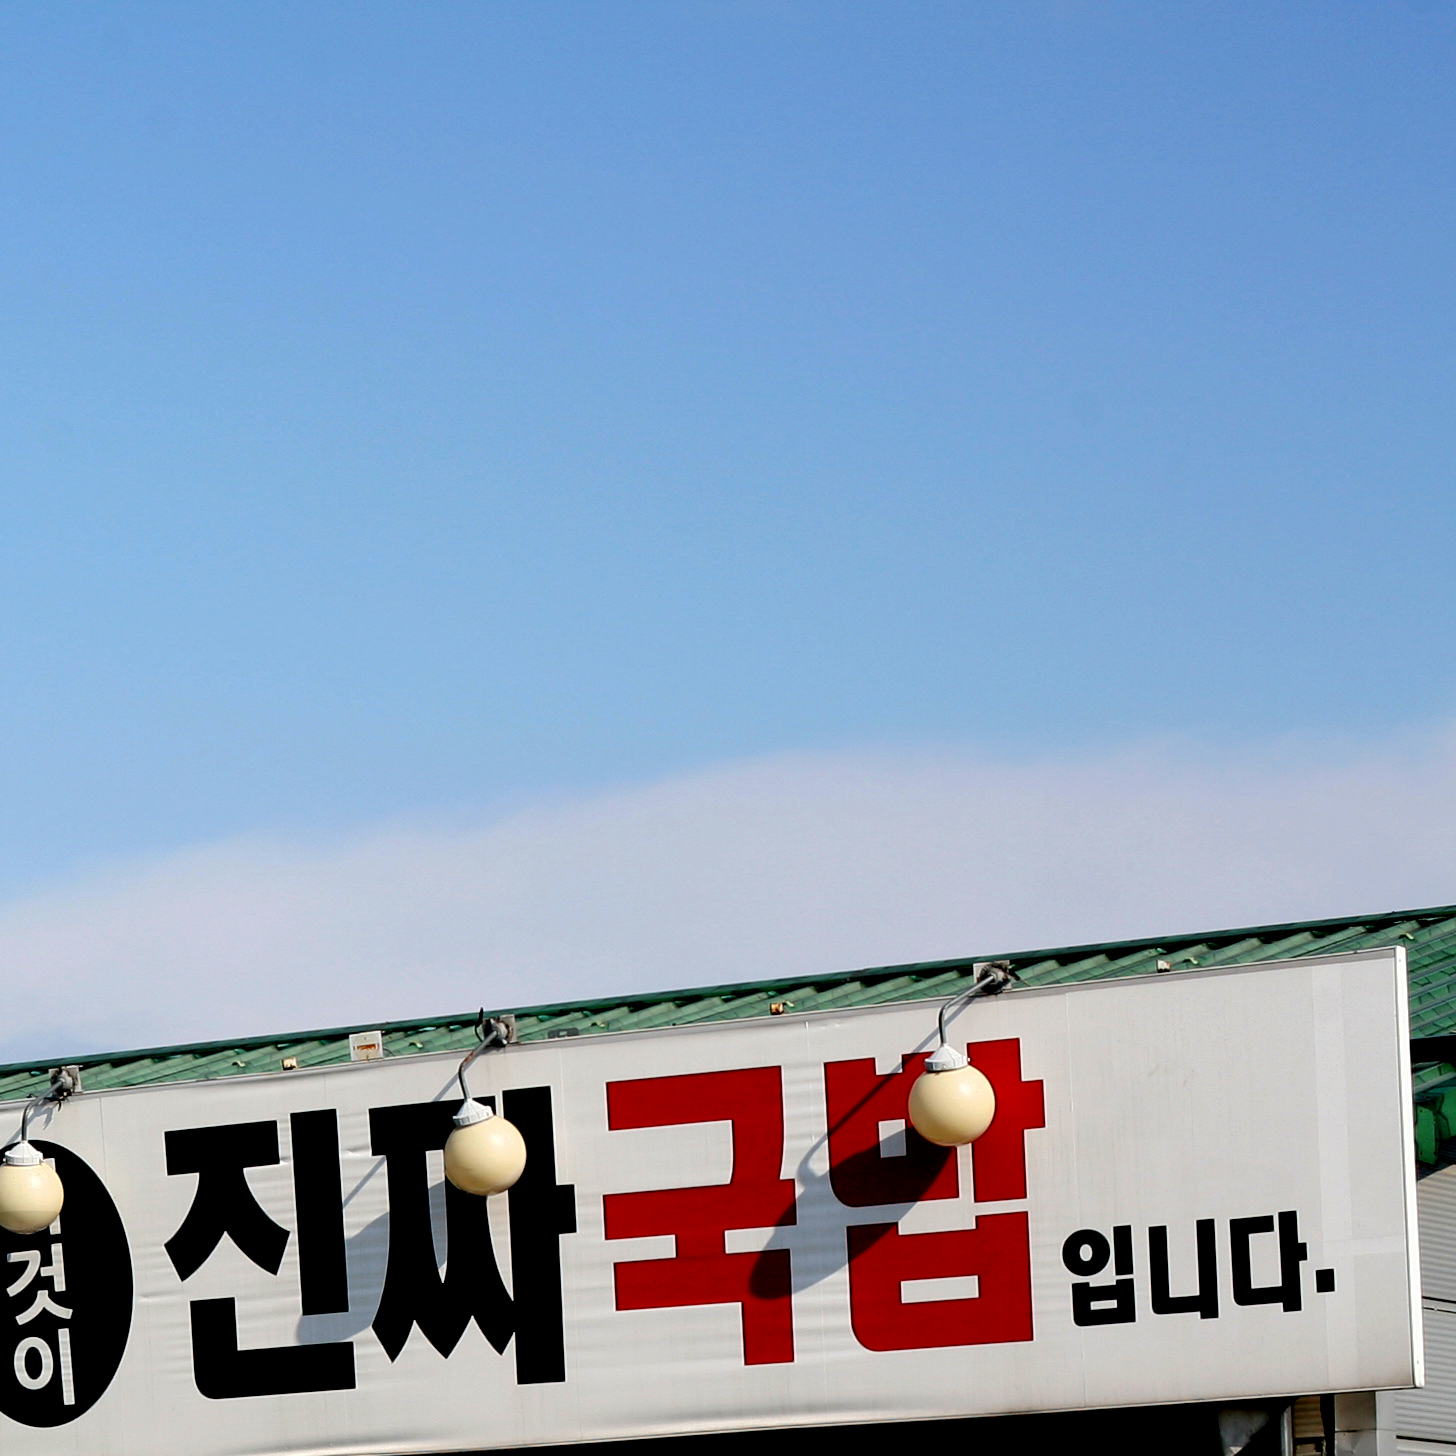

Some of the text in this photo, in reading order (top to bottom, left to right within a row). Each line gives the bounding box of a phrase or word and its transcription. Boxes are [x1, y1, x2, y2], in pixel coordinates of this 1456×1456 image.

[6, 1158, 76, 1406] 것이
[163, 1037, 1336, 1400] 진짜 국밥 입니다.
